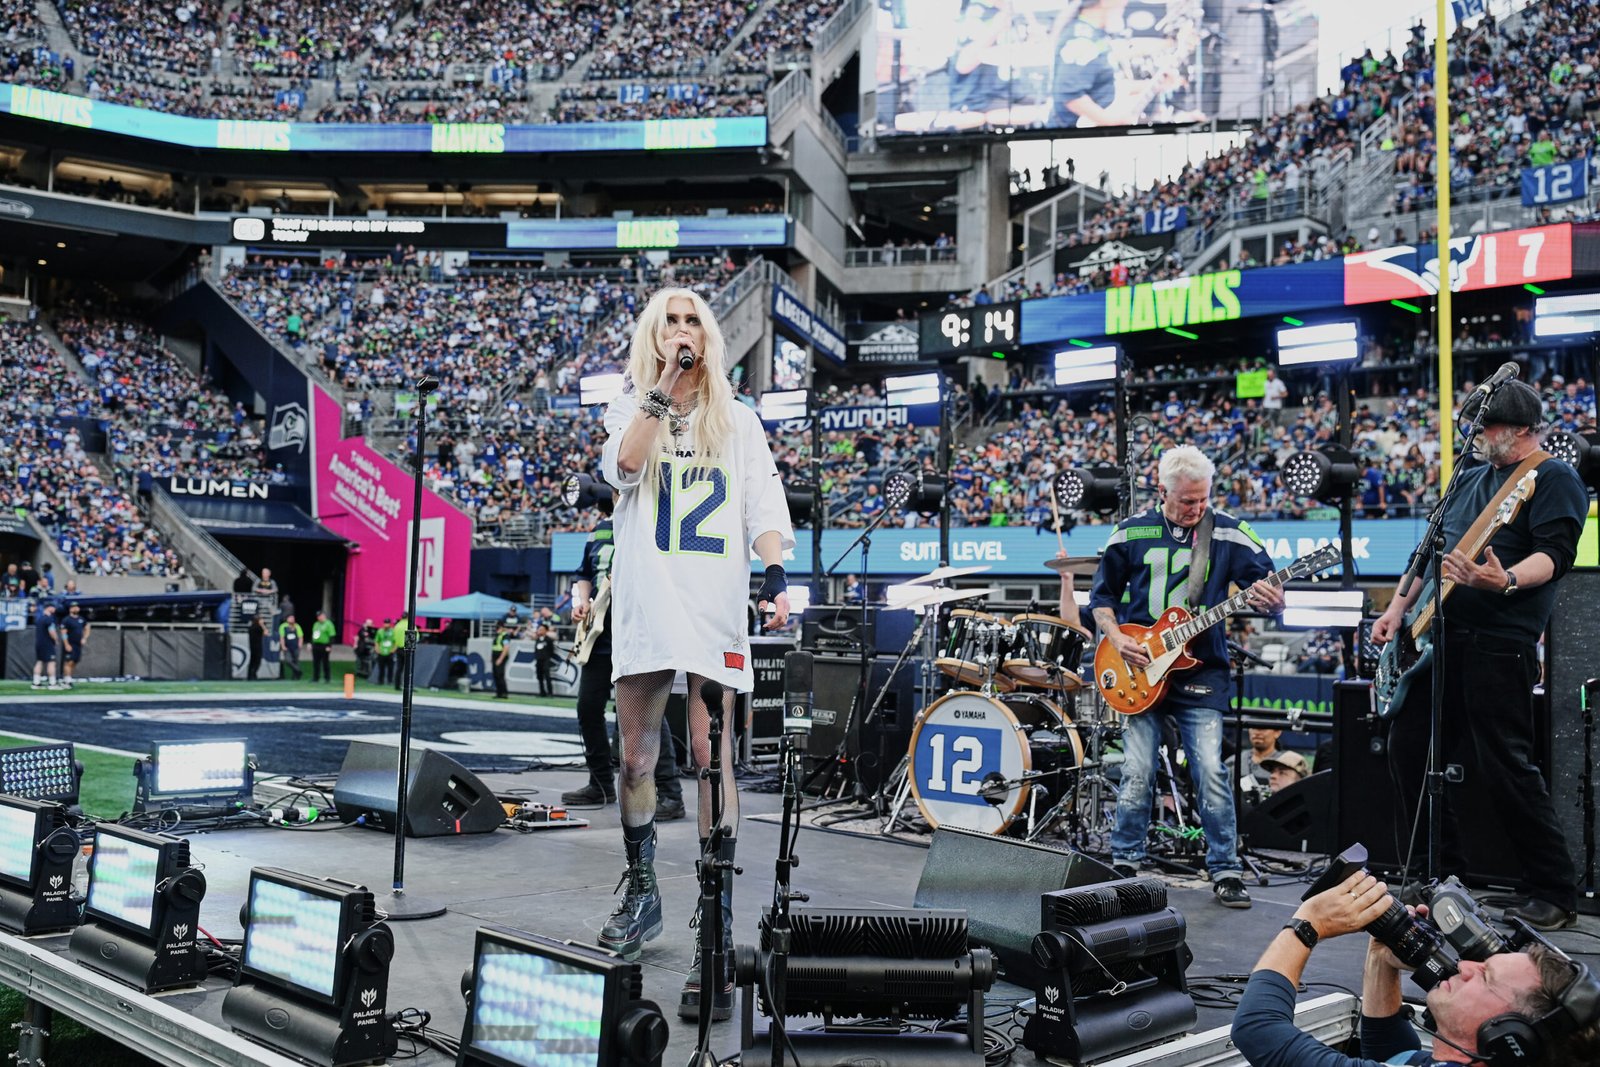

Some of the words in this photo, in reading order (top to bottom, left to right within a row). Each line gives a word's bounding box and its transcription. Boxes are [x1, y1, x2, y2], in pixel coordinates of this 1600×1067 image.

[10, 84, 93, 128] HAWKS
[624, 85, 644, 104] 12
[217, 119, 291, 151] HAWKS
[432, 123, 505, 152] HAWKS
[644, 118, 718, 149] HAWKS
[1533, 164, 1573, 203] 12
[1151, 206, 1179, 233] 12
[616, 220, 680, 248] HAWKS
[1105, 269, 1241, 335] HAWKS
[820, 407, 908, 430] HYUNDAI
[170, 477, 269, 499] LUMEN
[328, 453, 377, 501] America's
[375, 485, 401, 519] Best
[653, 458, 731, 558] 12
[900, 541, 941, 561] SUIT
[952, 541, 1007, 561] LEVEL
[760, 671, 766, 681] 2
[767, 671, 782, 681] WAY
[962, 710, 986, 720] YAMAHA
[927, 733, 983, 796] 12
[166, 940, 194, 949] PALADIN
[353, 1009, 383, 1019] PALADIN
[1038, 1004, 1065, 1015] PALADIN
[1042, 1013, 1060, 1022] PANEL
[357, 1018, 378, 1026] PANEL
[1504, 1035, 1525, 1058] RTS
